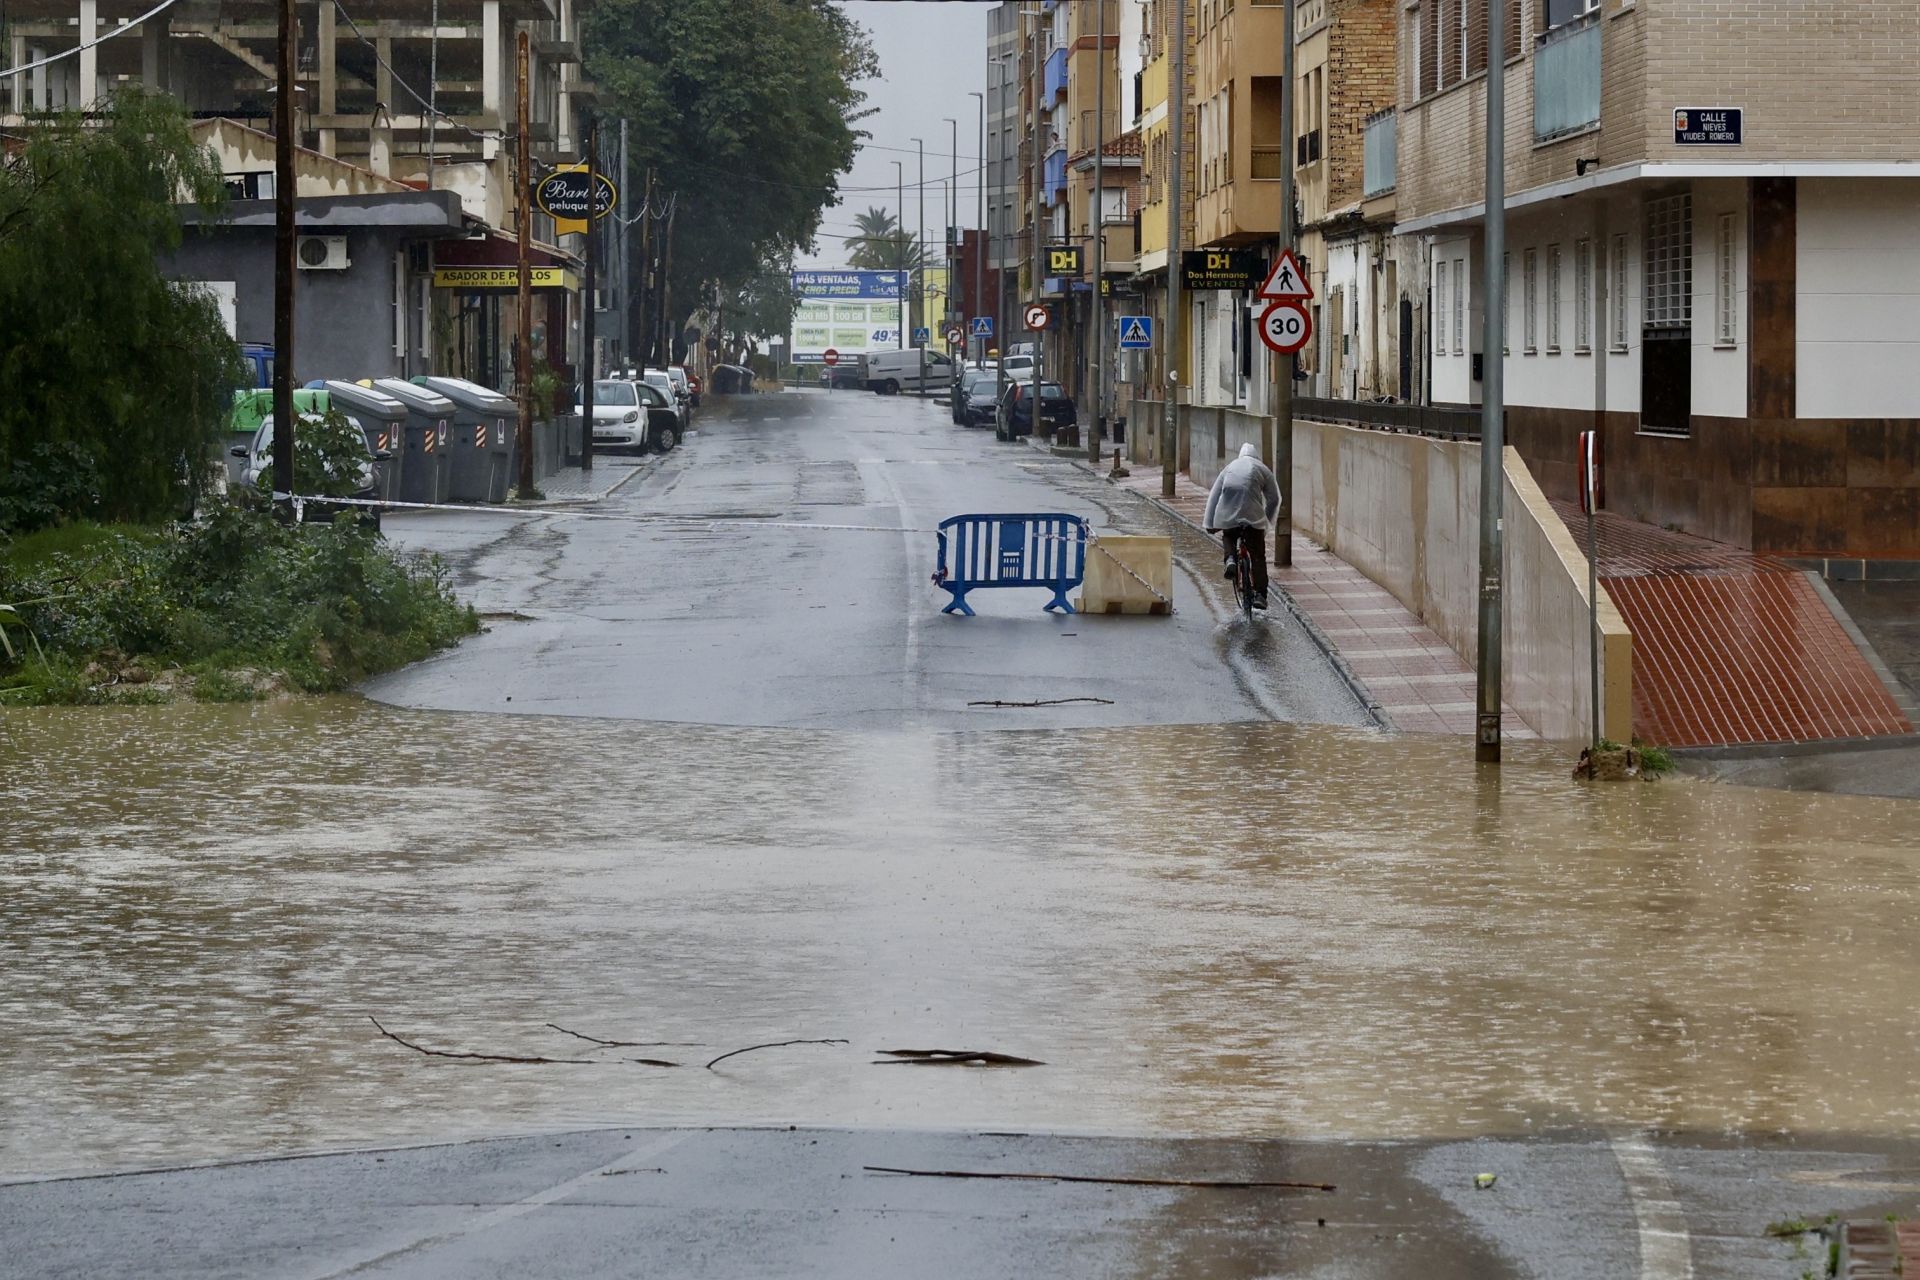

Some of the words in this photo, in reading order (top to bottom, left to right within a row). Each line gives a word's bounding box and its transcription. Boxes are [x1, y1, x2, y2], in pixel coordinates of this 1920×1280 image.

[1701, 112, 1727, 122] CALLE
[1702, 123, 1727, 132] NIEVES
[1682, 132, 1706, 141] VIUDES
[1709, 132, 1735, 141] ROMERO
[545, 180, 610, 199] Bartlo
[549, 200, 606, 212] peluqueos
[1051, 251, 1077, 269] DH
[1208, 254, 1230, 269] DH
[443, 271, 487, 280] ASADOR
[491, 271, 506, 280] DE
[1188, 271, 1204, 279] Dos
[1206, 271, 1249, 279] Hermanos
[818, 275, 862, 286] VENTAJAS,
[1191, 280, 1246, 288] EVENTOS
[829, 285, 860, 295] PRECIO
[836, 312, 850, 321] 100
[1271, 318, 1300, 335] 30
